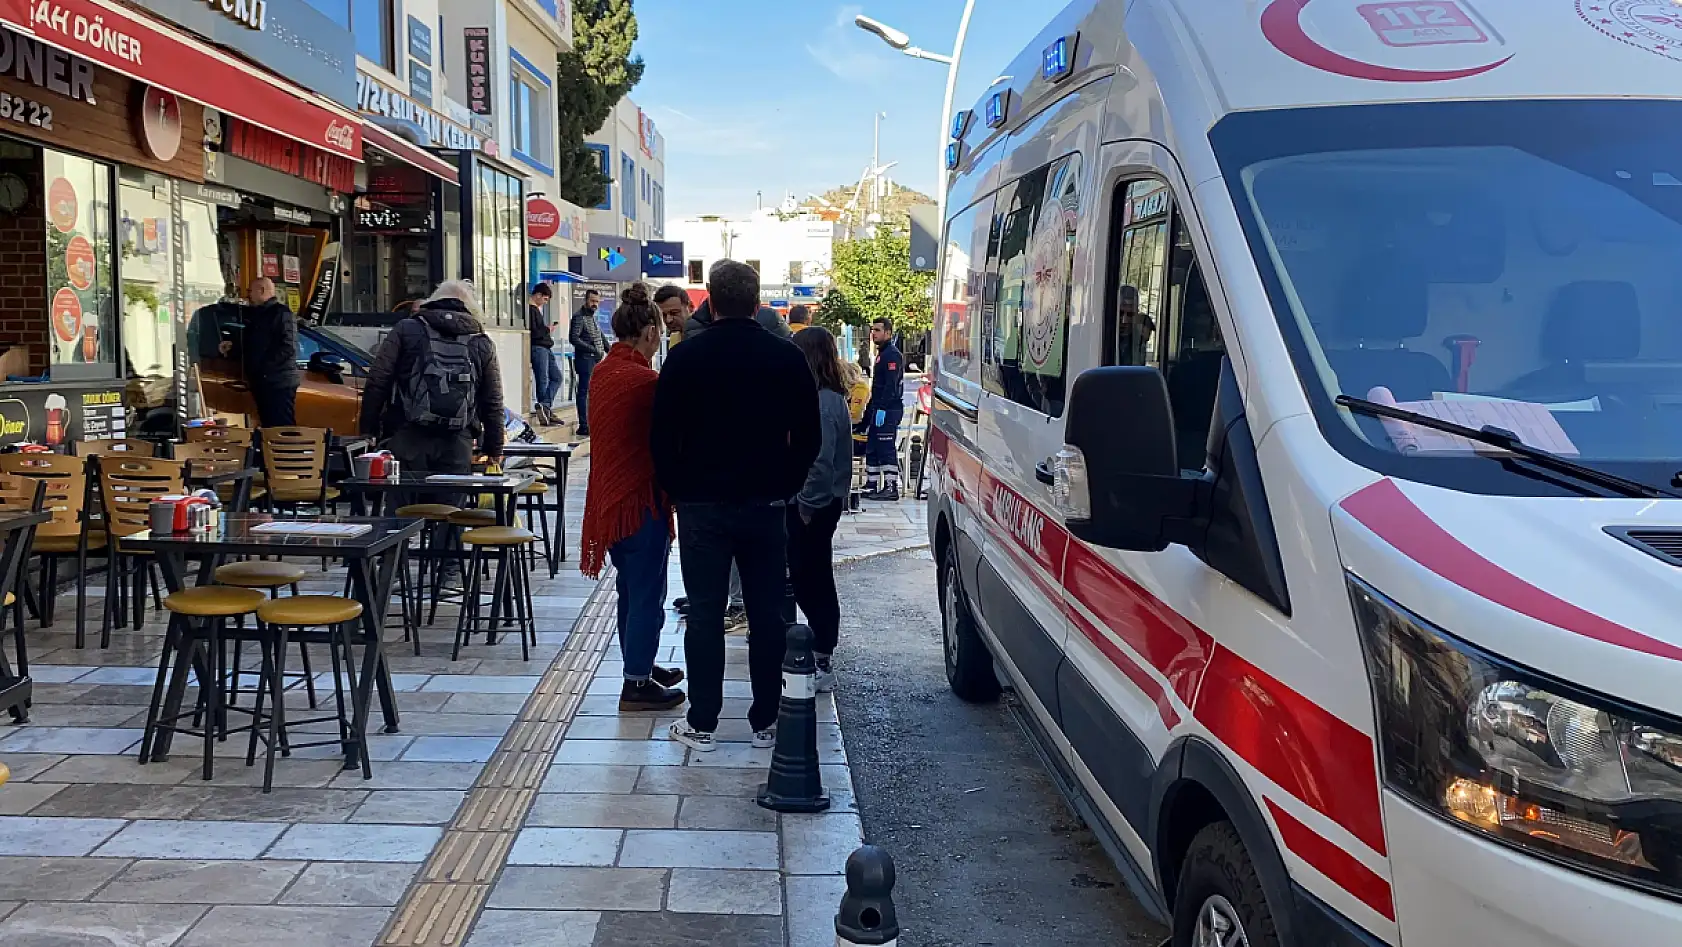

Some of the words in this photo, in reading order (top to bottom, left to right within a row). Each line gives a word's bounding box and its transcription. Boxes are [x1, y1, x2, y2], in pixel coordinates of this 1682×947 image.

[31, 0, 70, 35] AH
[74, 14, 142, 65] DÖNER
[1375, 6, 1458, 26] 112
[28, 101, 53, 131] 22
[992, 483, 1044, 555] AMBULANS
